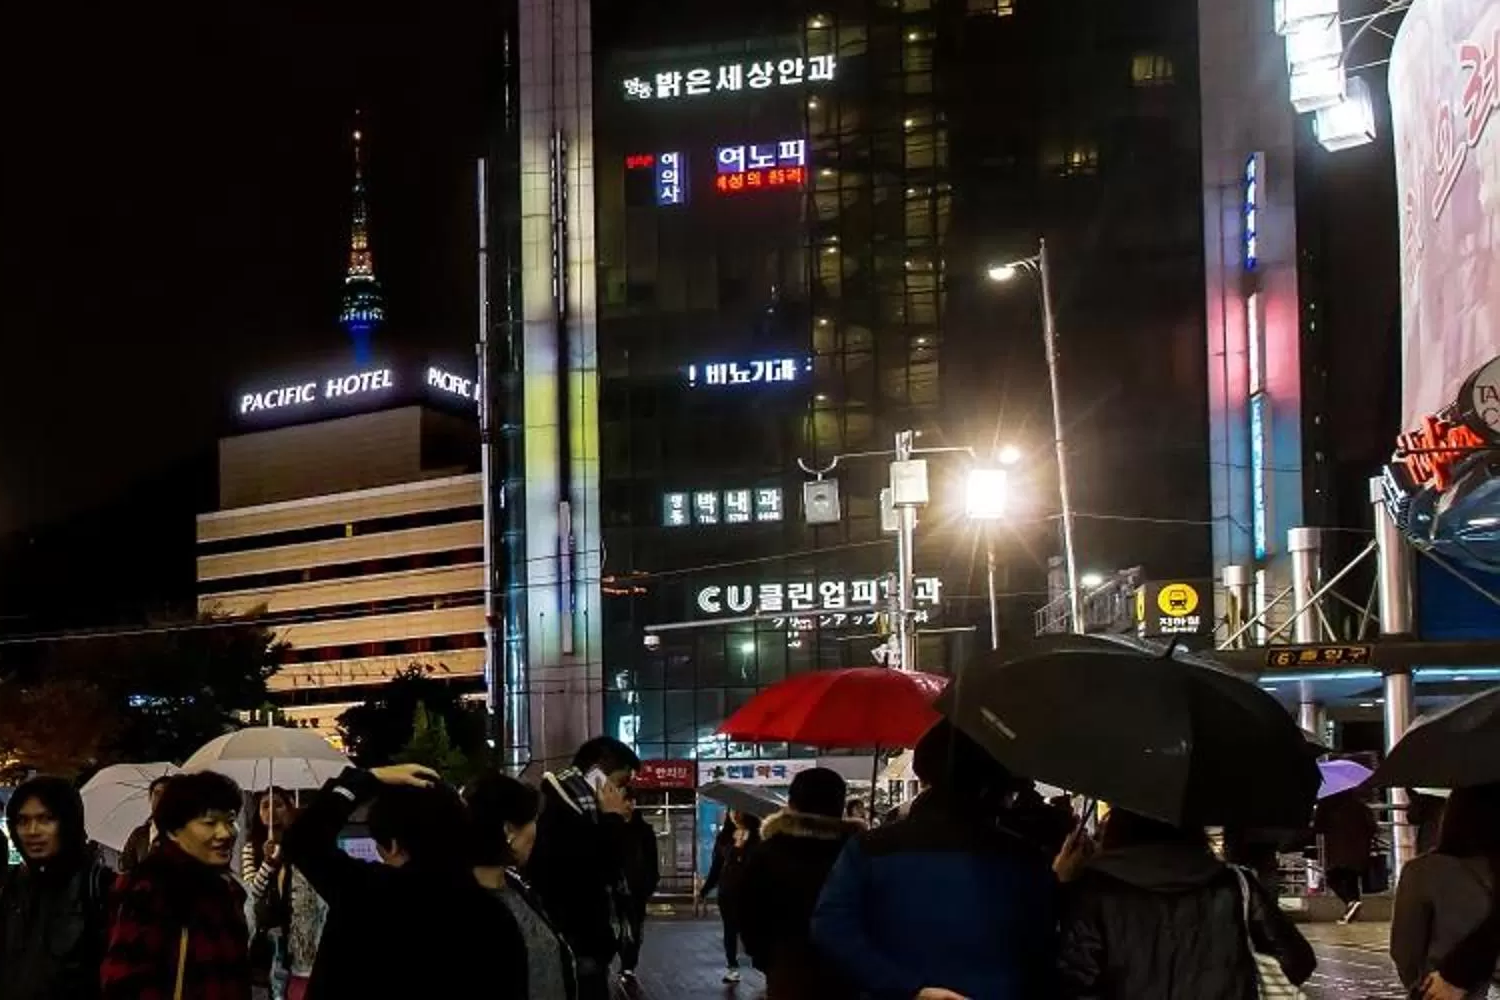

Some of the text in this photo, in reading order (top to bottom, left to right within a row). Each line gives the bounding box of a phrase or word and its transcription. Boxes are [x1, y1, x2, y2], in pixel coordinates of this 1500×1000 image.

[655, 54, 837, 98] 밝은세상안과
[241, 369, 393, 413] PACIFIC HOTEL
[427, 367, 471, 397] PACIFIC
